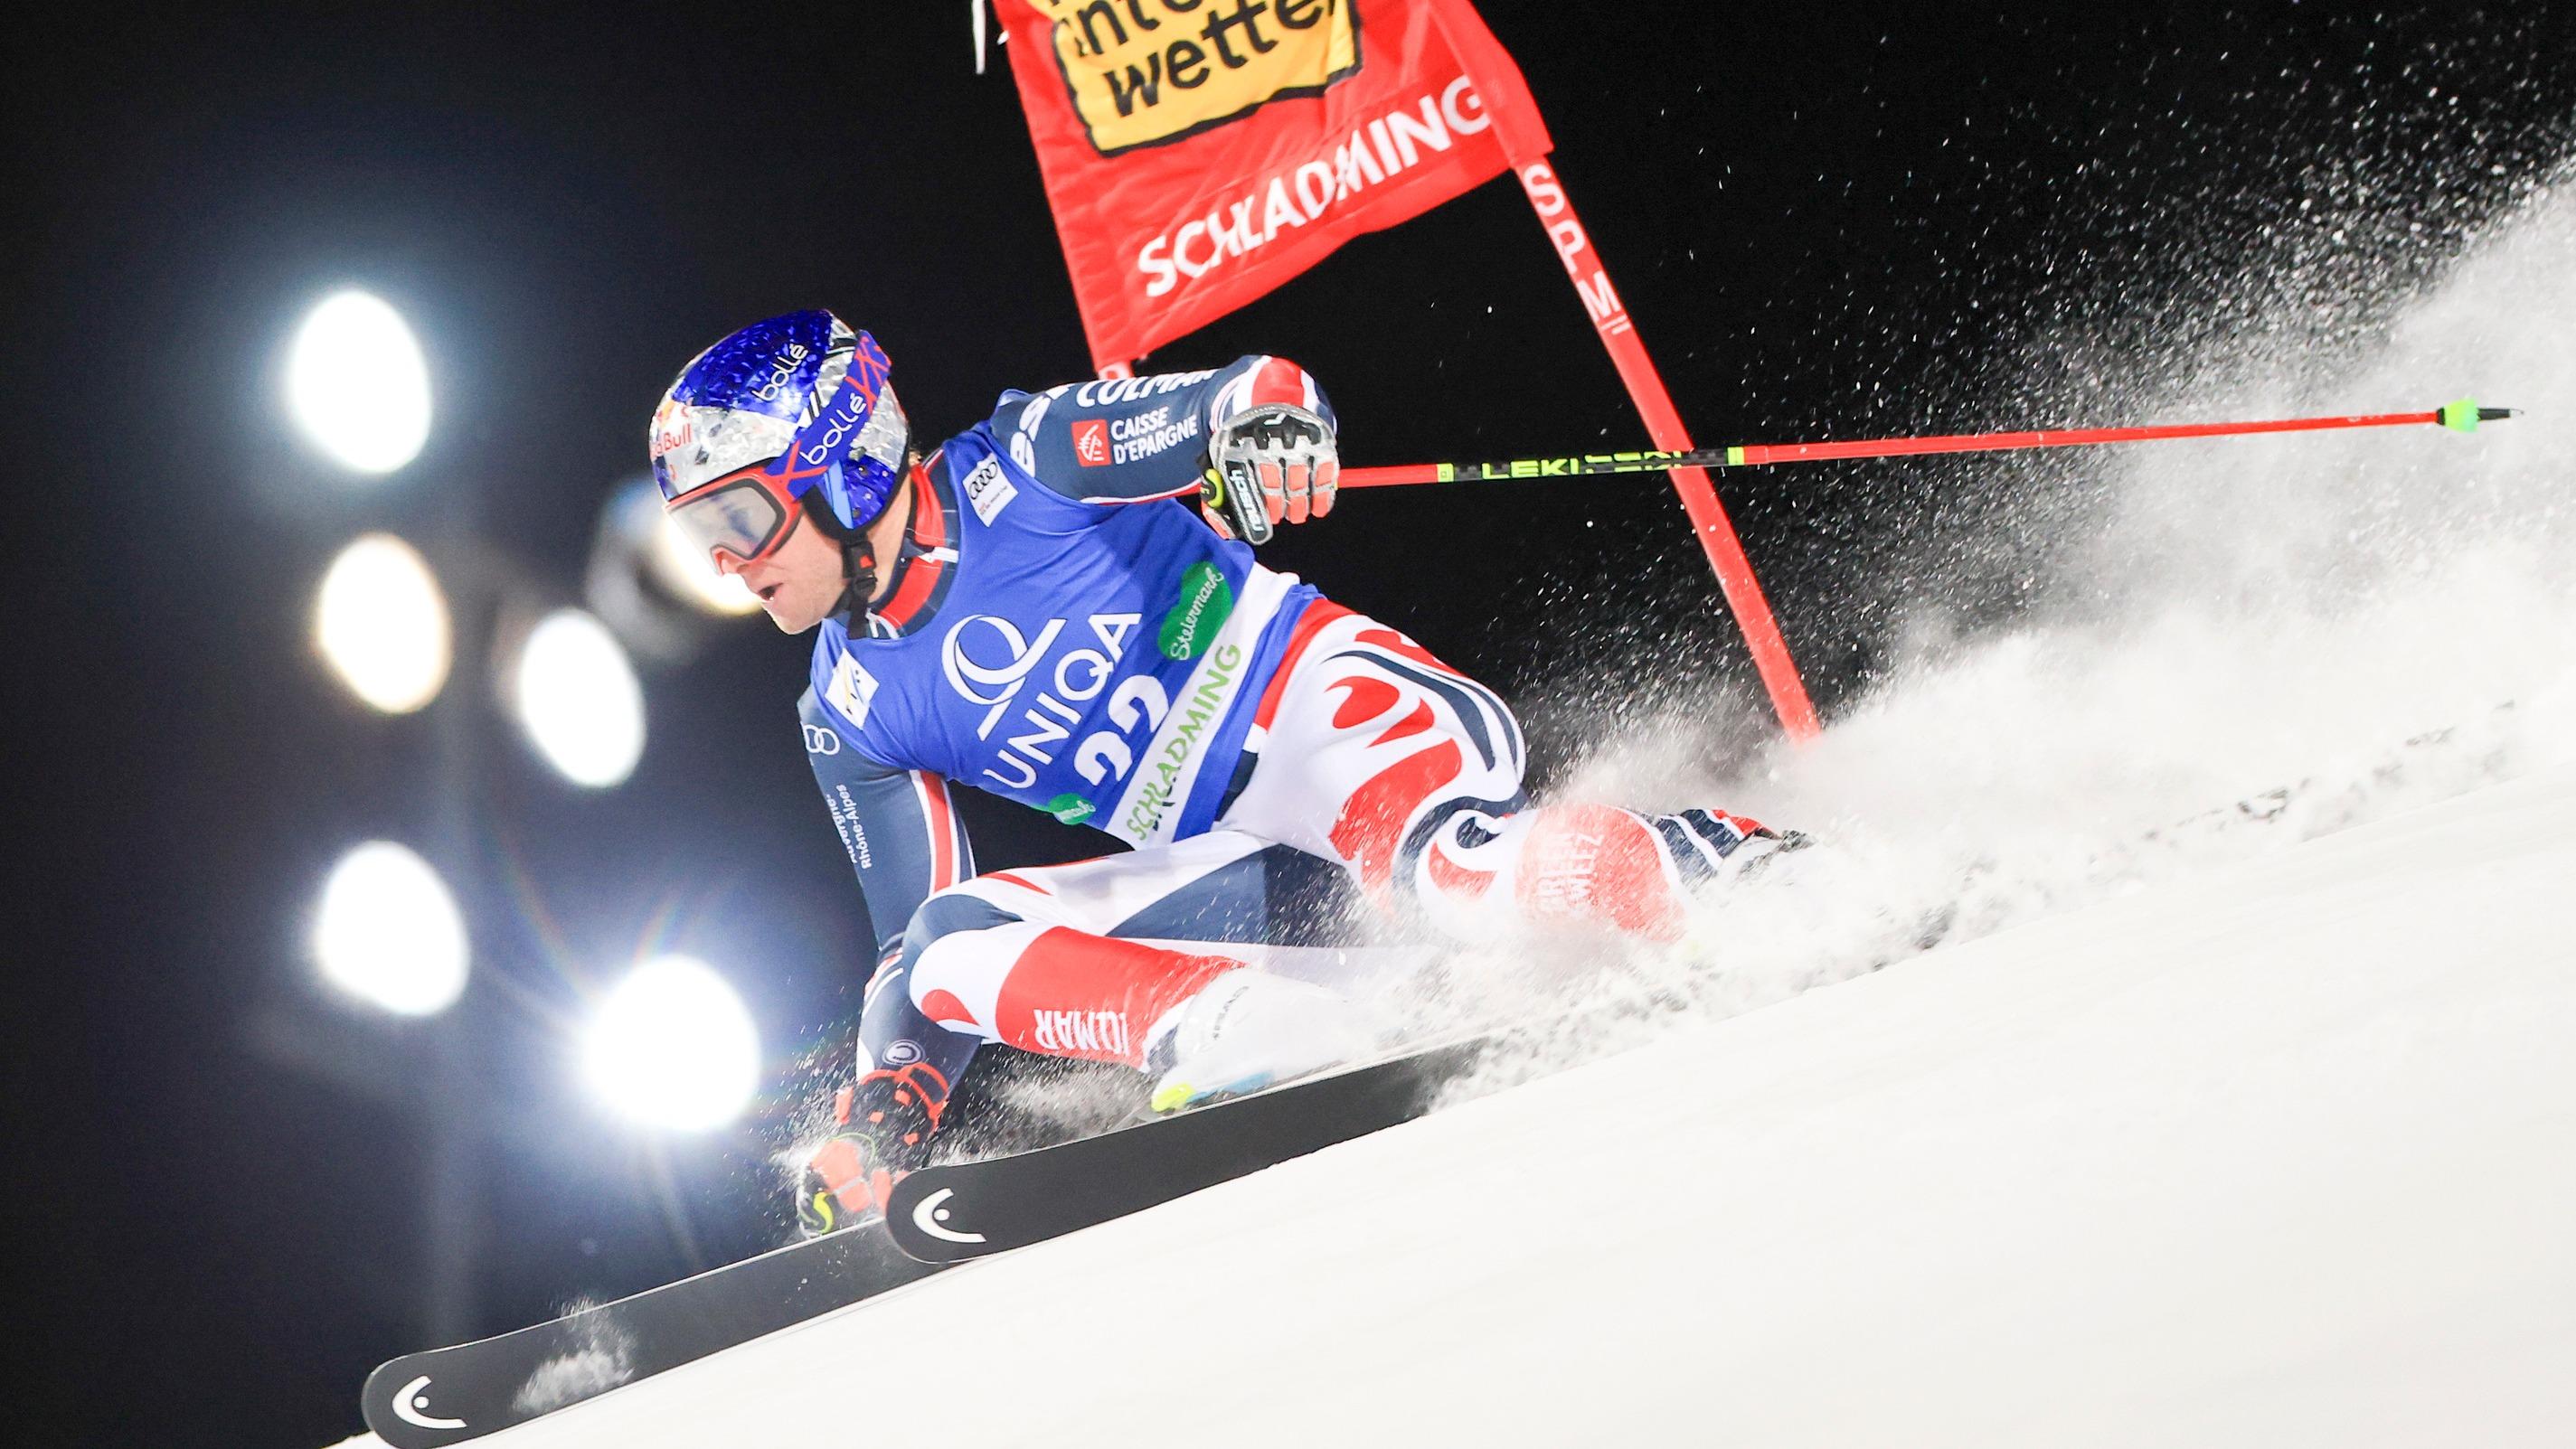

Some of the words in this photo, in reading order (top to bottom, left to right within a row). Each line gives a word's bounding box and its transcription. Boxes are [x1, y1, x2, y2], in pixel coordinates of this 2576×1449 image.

[1103, 0, 1335, 118] wette
[1137, 75, 1494, 297] SCHLADMING
[752, 343, 809, 402] bollé
[663, 423, 693, 450] Bull
[799, 393, 867, 466] bollé
[1110, 406, 1170, 442] CAISSE
[1112, 414, 1199, 465] D'EPARGNE
[1481, 457, 1580, 480] LEKI
[1170, 567, 1224, 661] Steiermark
[982, 612, 1143, 790] UNIQA
[1125, 643, 1242, 842] SCHLADMING
[835, 784, 873, 870] Rhône-Alpes
